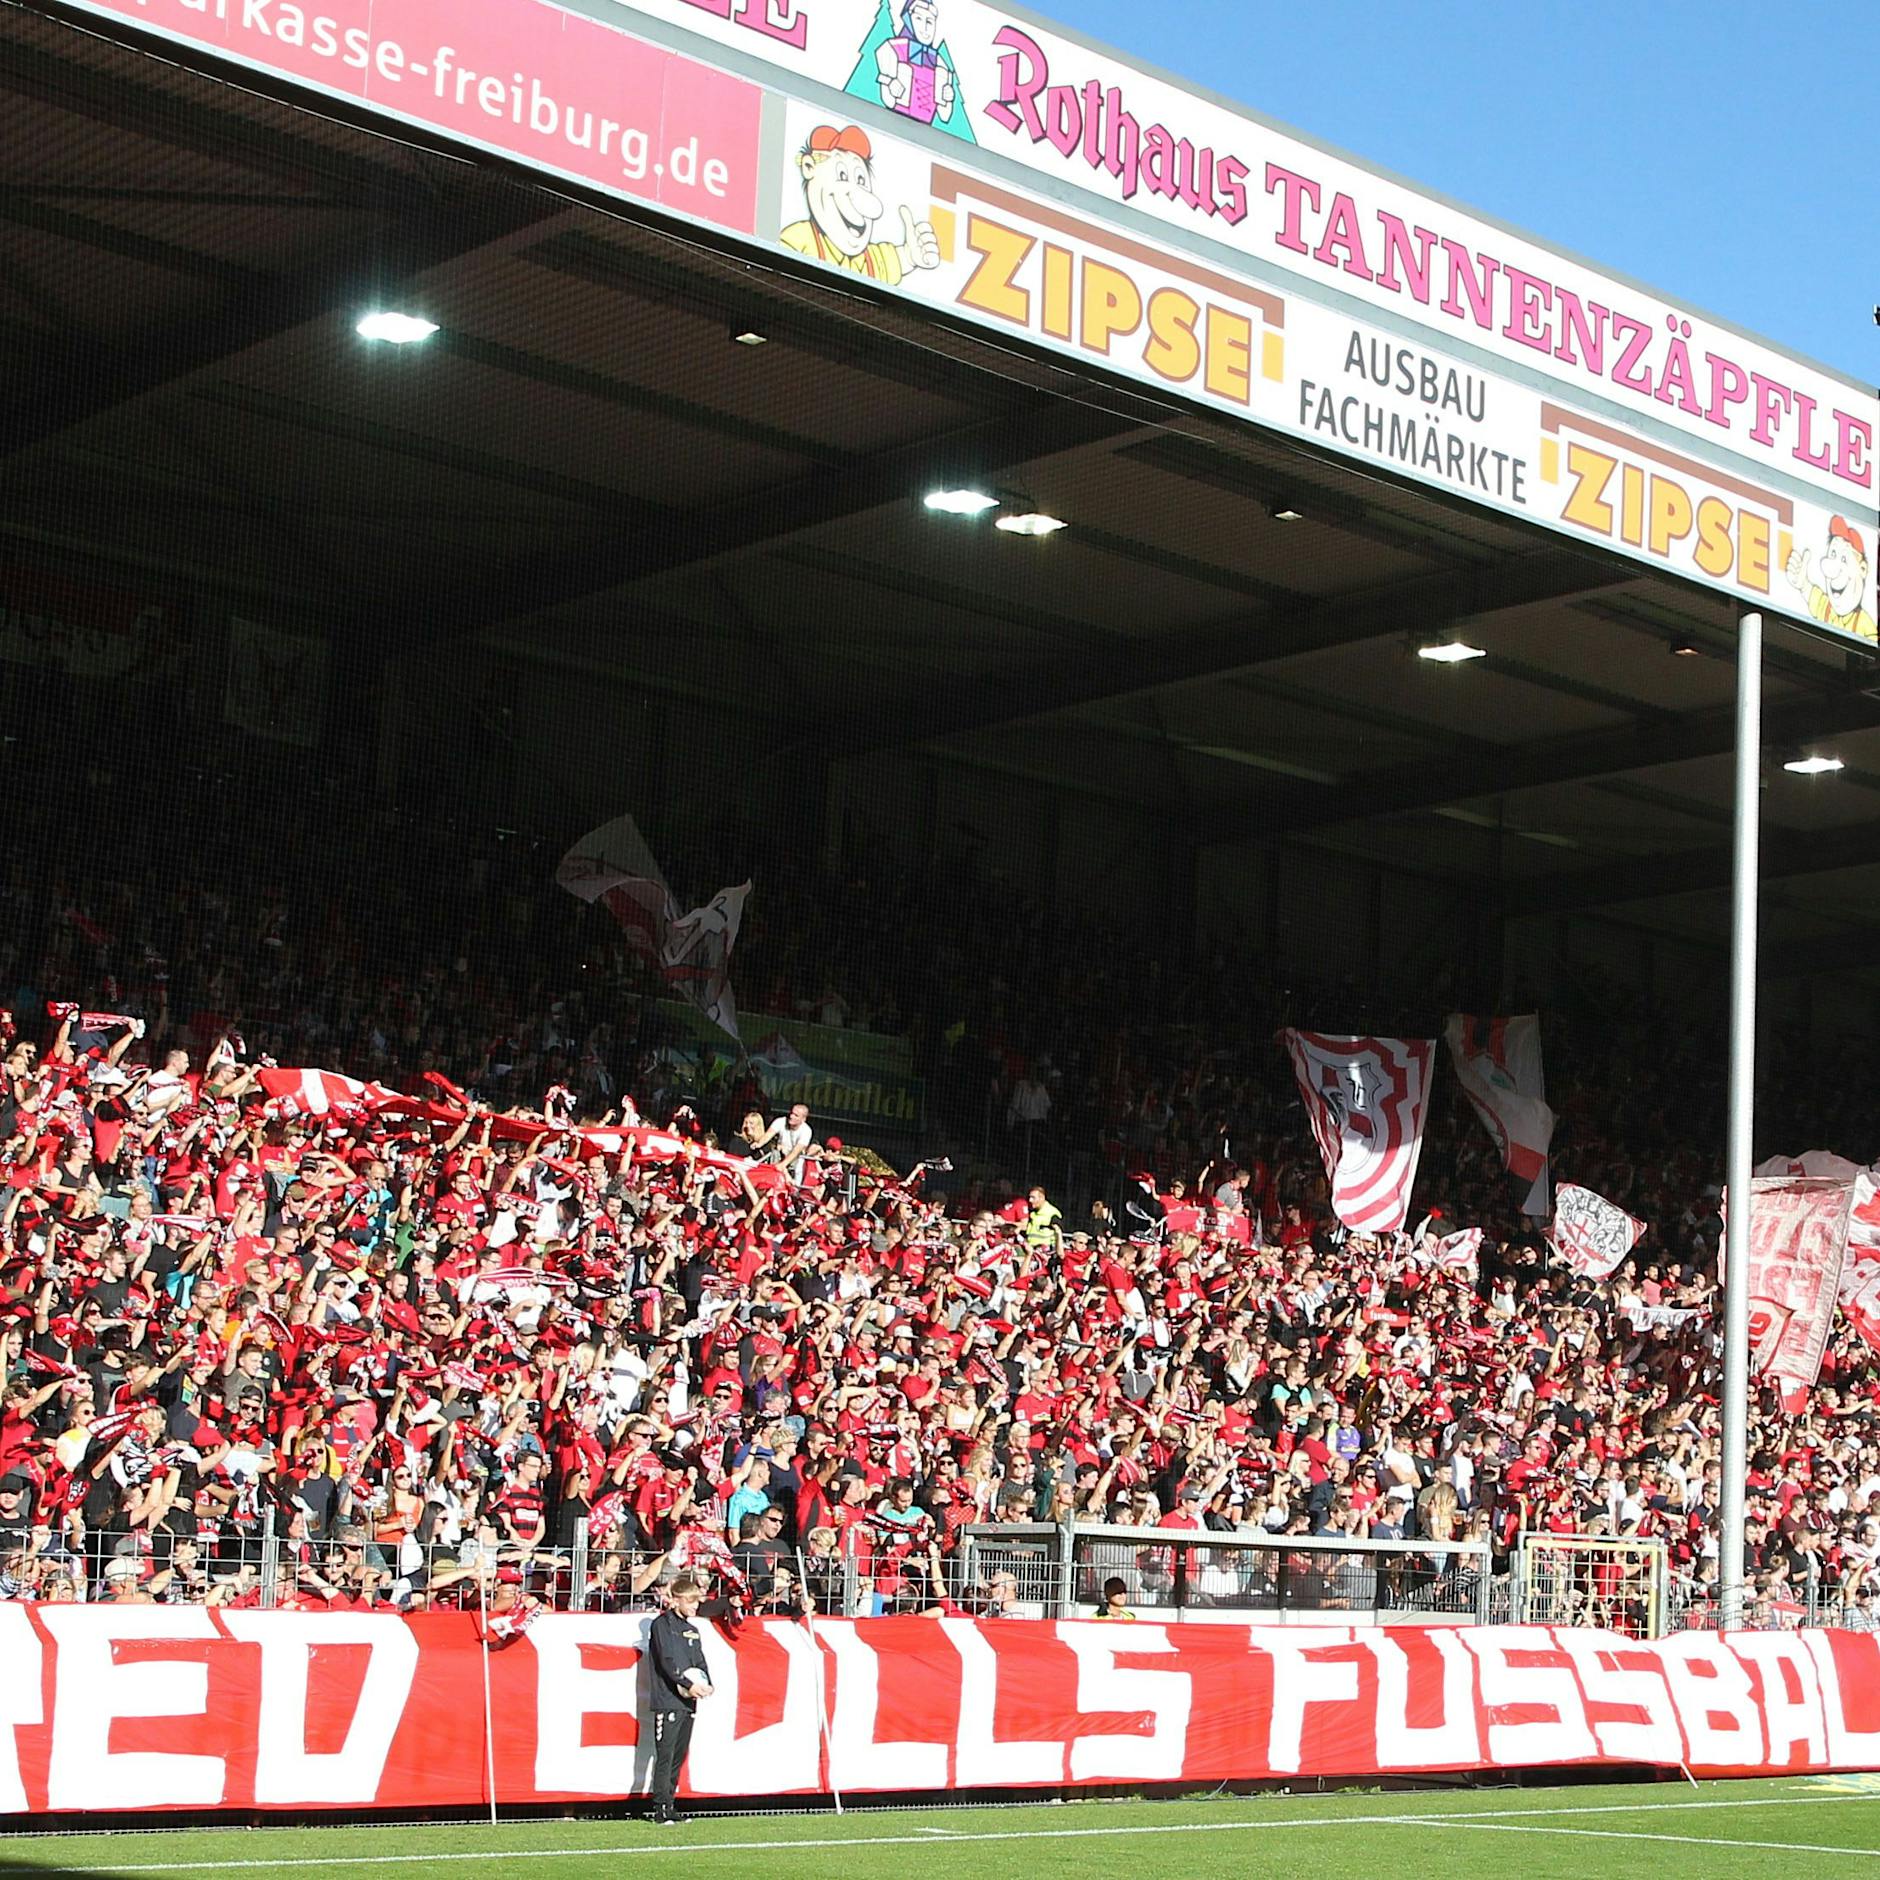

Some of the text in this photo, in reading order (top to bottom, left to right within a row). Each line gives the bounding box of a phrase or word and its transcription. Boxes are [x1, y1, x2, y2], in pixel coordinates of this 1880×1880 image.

[955, 211, 1252, 406] ZIPSE
[982, 24, 1872, 489] Rothaus TANNENZÄPFLE
[1300, 379, 1527, 504] FACHMÄRKTE
[1344, 330, 1486, 423] AUSBAU
[1561, 441, 1770, 595] ZIPSE
[1248, 1624, 1880, 1773] FUSSBAL
